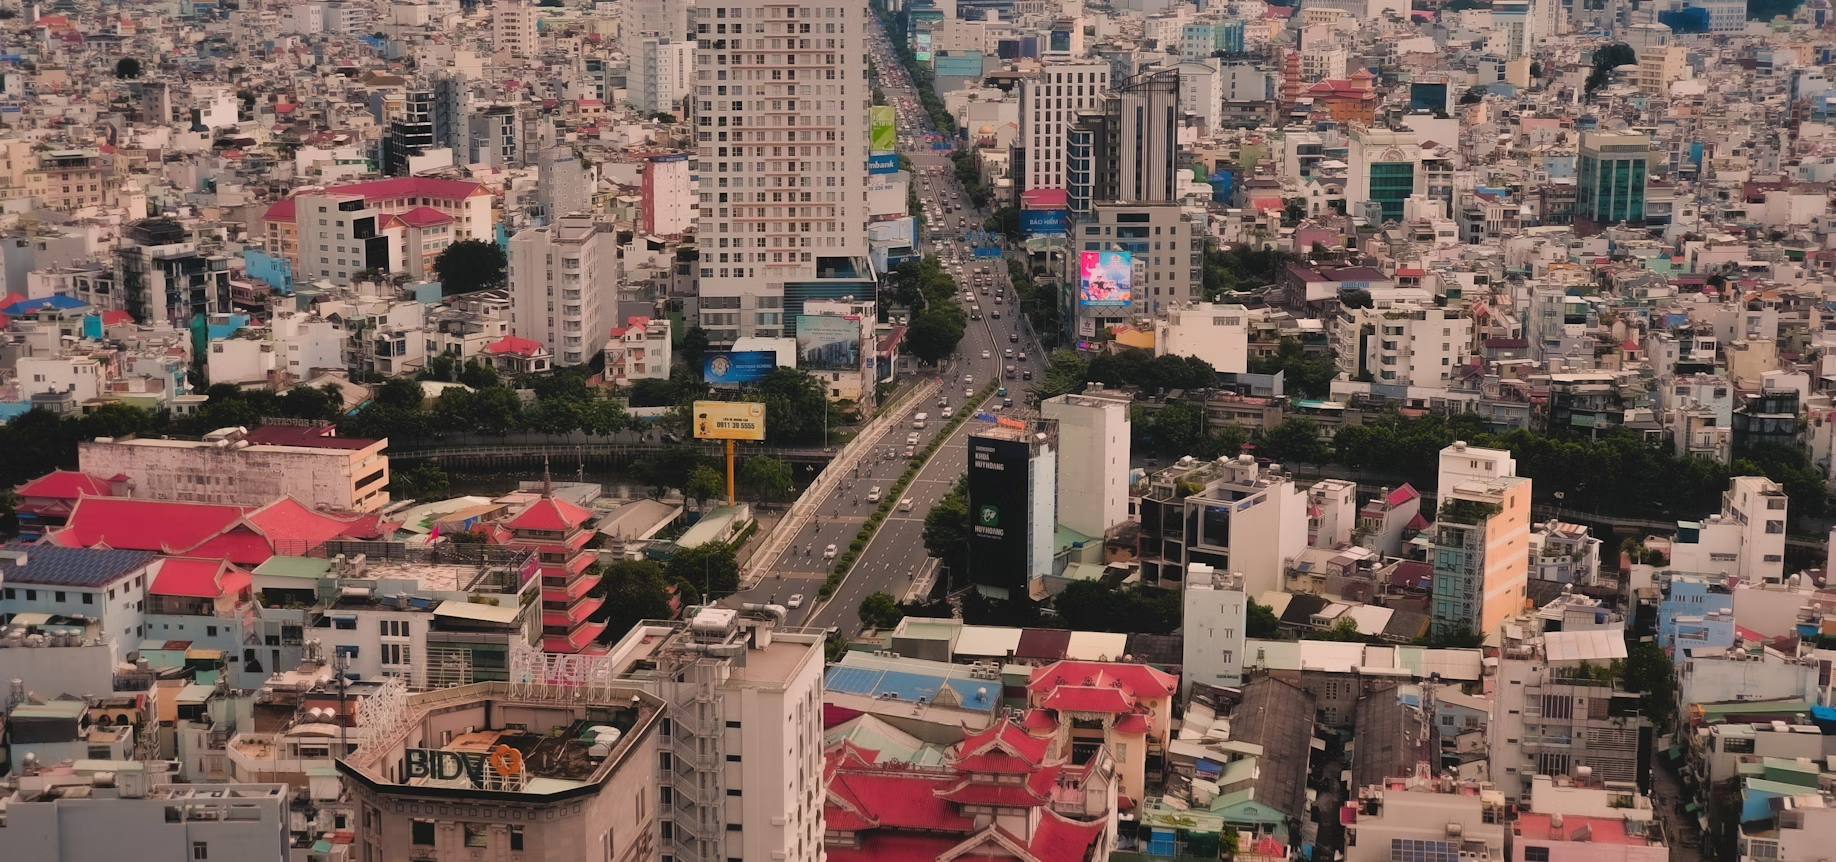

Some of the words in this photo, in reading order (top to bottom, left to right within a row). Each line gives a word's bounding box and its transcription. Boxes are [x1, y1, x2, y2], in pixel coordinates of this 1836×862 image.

[716, 421, 730, 429] 0911
[740, 422, 755, 430] 5555
[406, 749, 488, 789] BIDV
